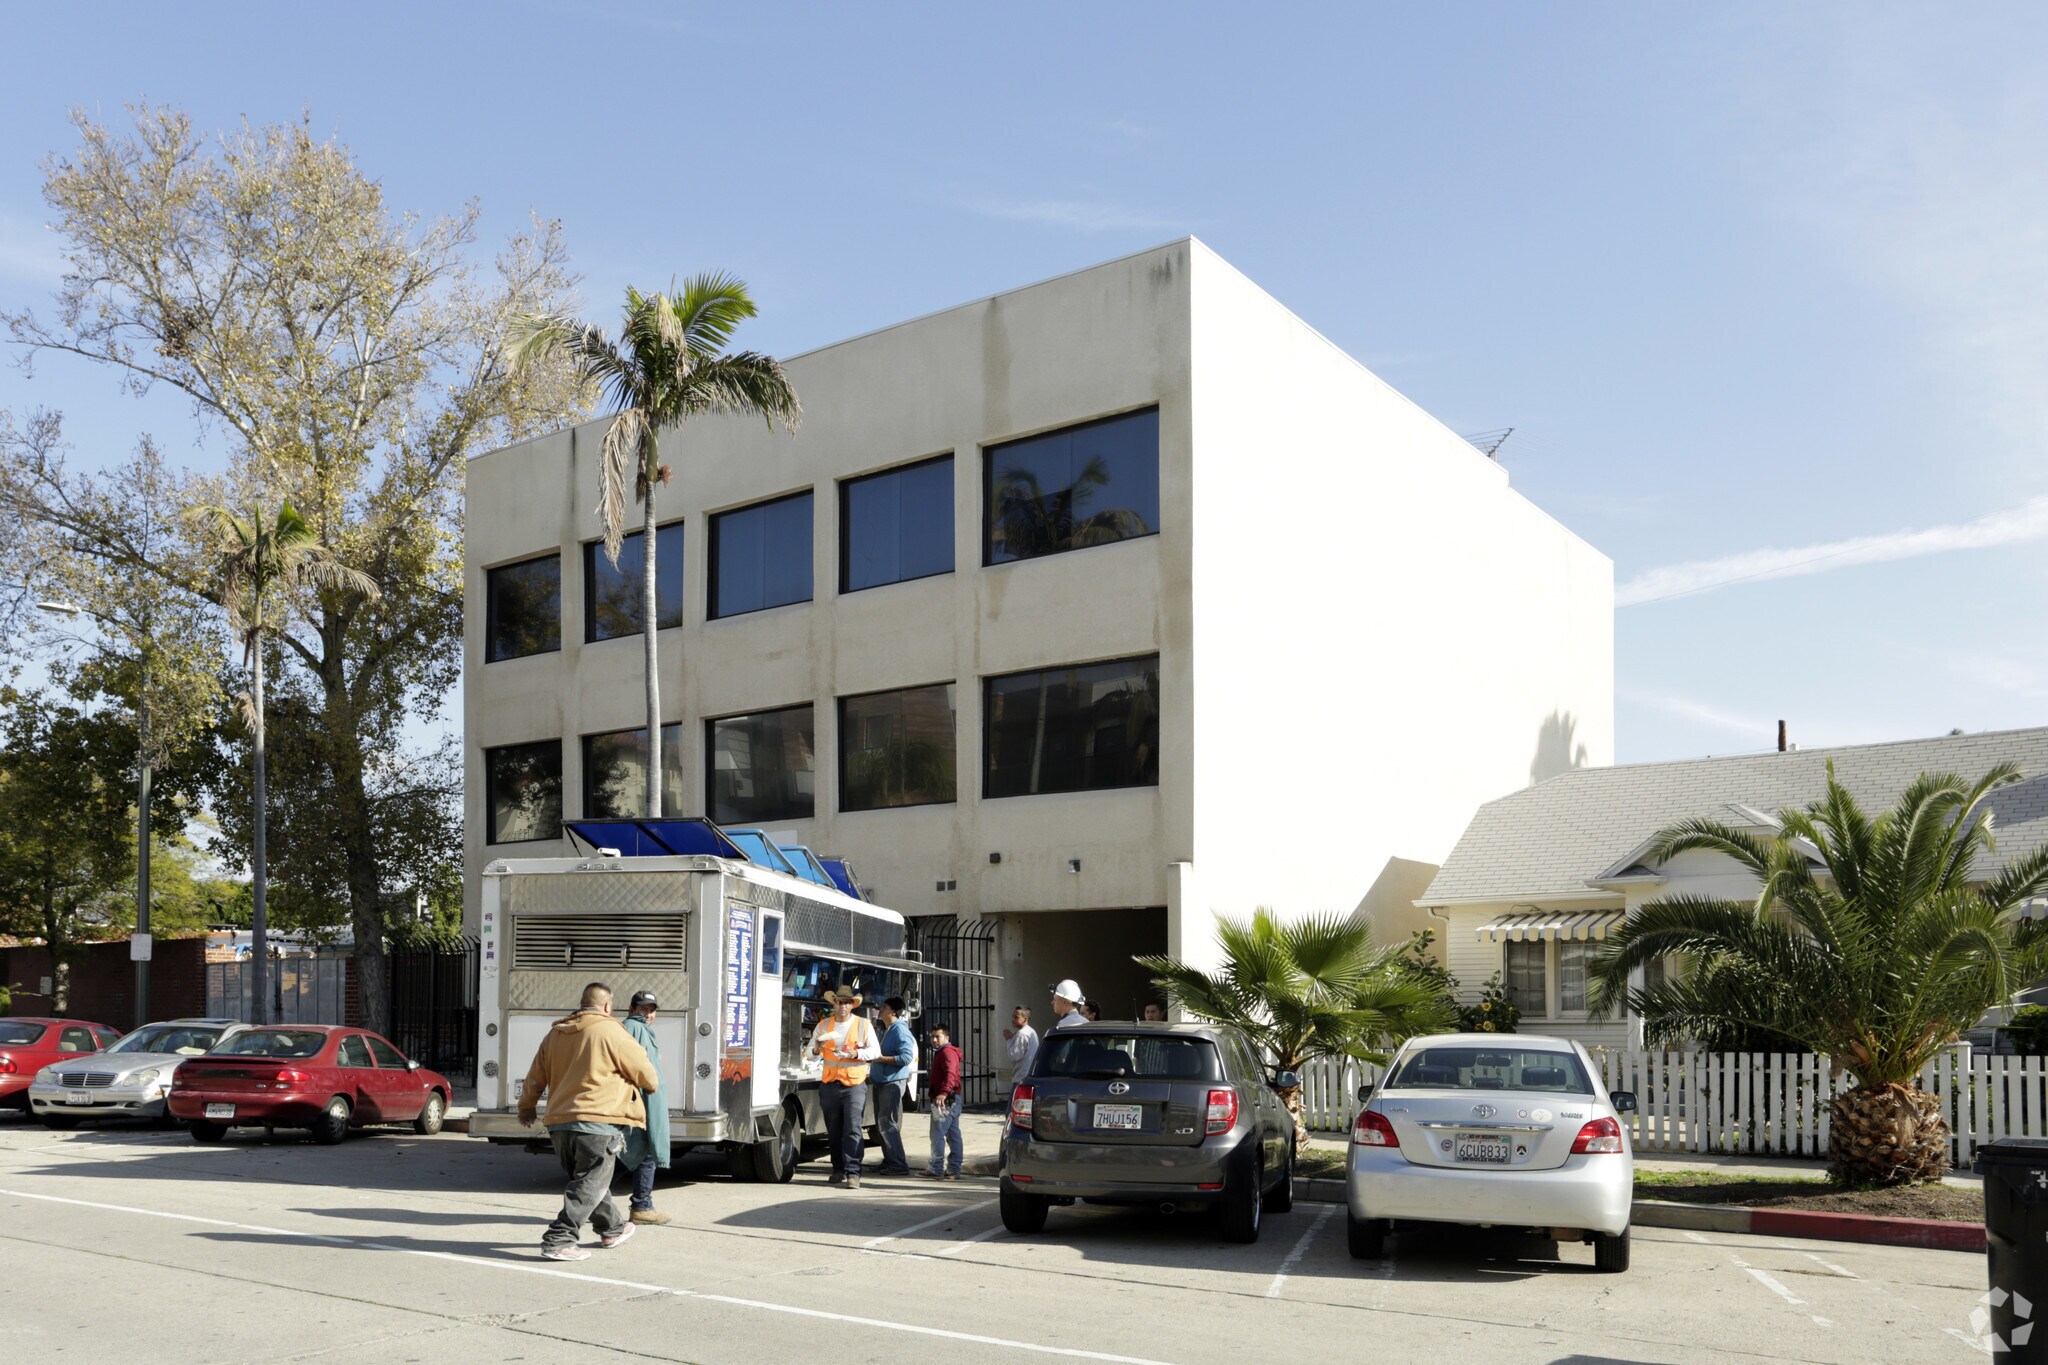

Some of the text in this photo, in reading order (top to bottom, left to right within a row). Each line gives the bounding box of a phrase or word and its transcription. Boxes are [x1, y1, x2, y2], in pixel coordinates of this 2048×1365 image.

[1098, 1113, 1138, 1124] 7HUJ156
[1174, 1127, 1194, 1135] xD
[1459, 1144, 1508, 1159] 6CUB833
